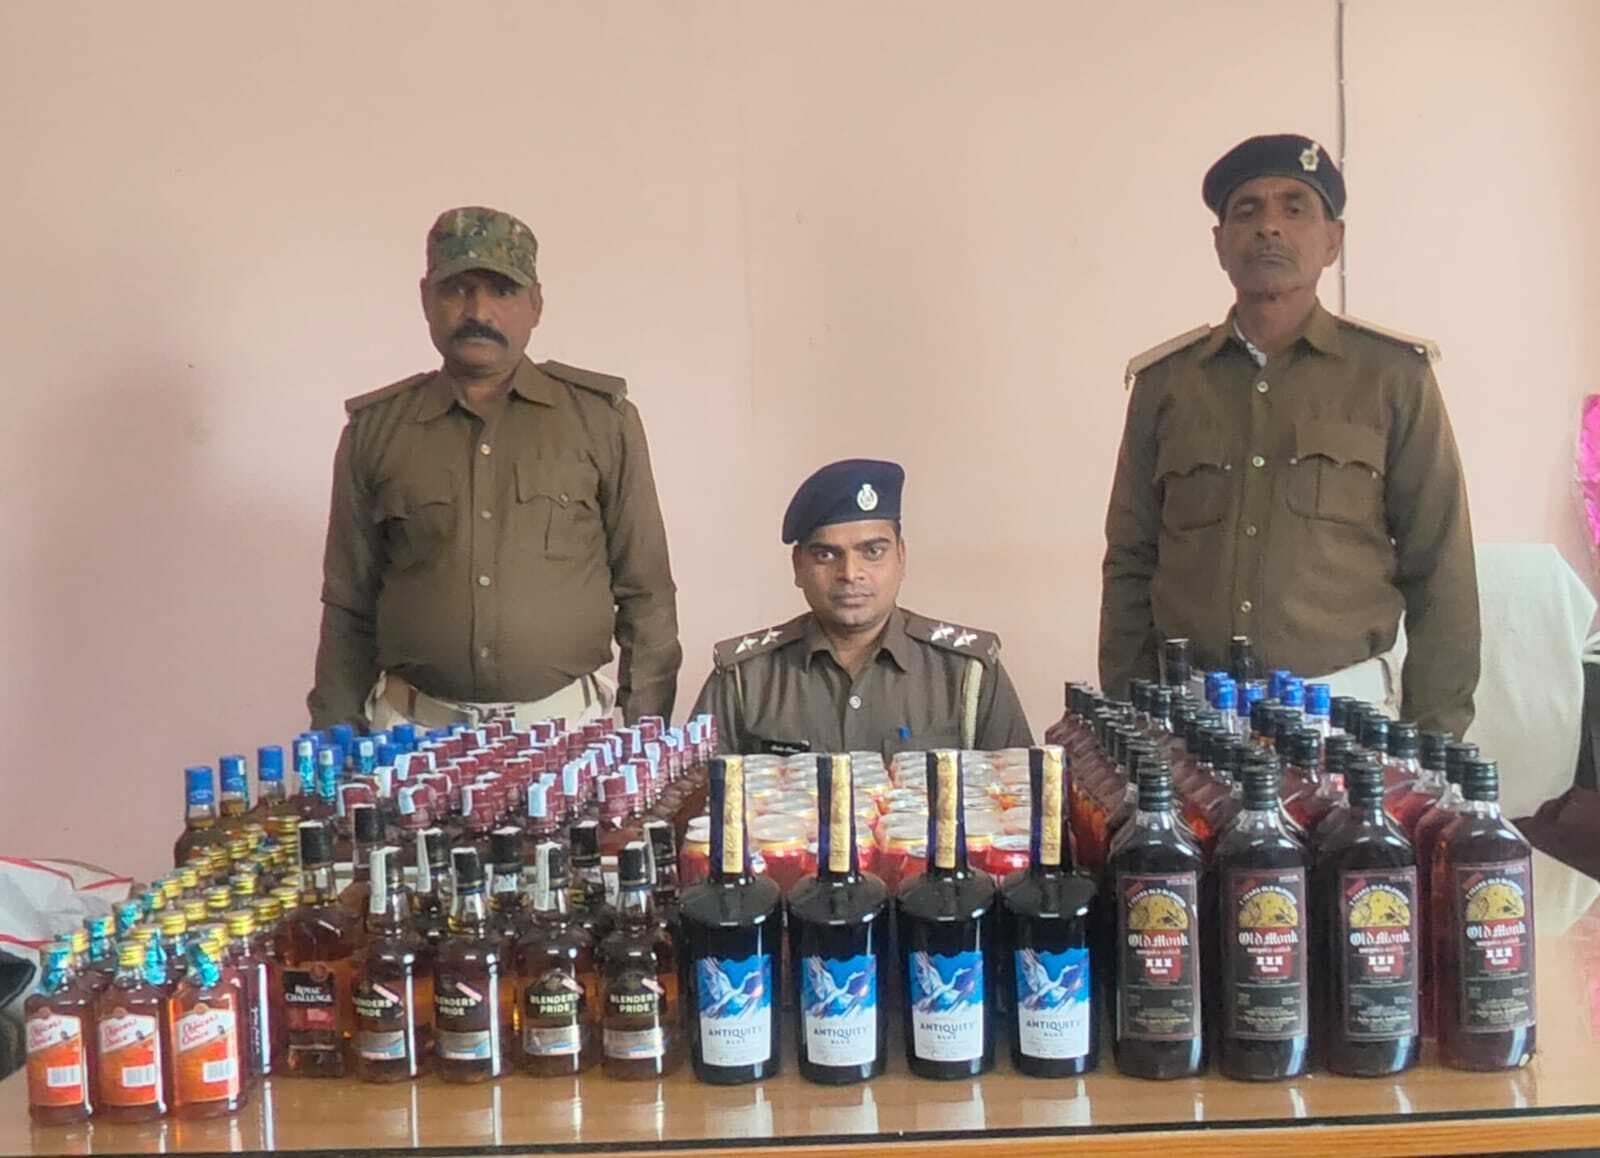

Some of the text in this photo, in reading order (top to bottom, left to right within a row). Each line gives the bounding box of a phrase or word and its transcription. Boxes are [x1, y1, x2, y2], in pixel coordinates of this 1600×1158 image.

[1467, 921, 1526, 939] Old Monk
[1128, 933, 1189, 948] Old Monk
[1239, 930, 1299, 947] Old Monk
[1350, 929, 1410, 946] Old Monk
[540, 1003, 570, 1014] PRIDE
[619, 1003, 650, 1013] PRIDE
[708, 1026, 762, 1040] ANTIQUITY
[813, 1026, 867, 1040] ANTIQUITY
[920, 1022, 974, 1036] ANTIQUITY
[1026, 1020, 1080, 1033] ANTIQUITY
